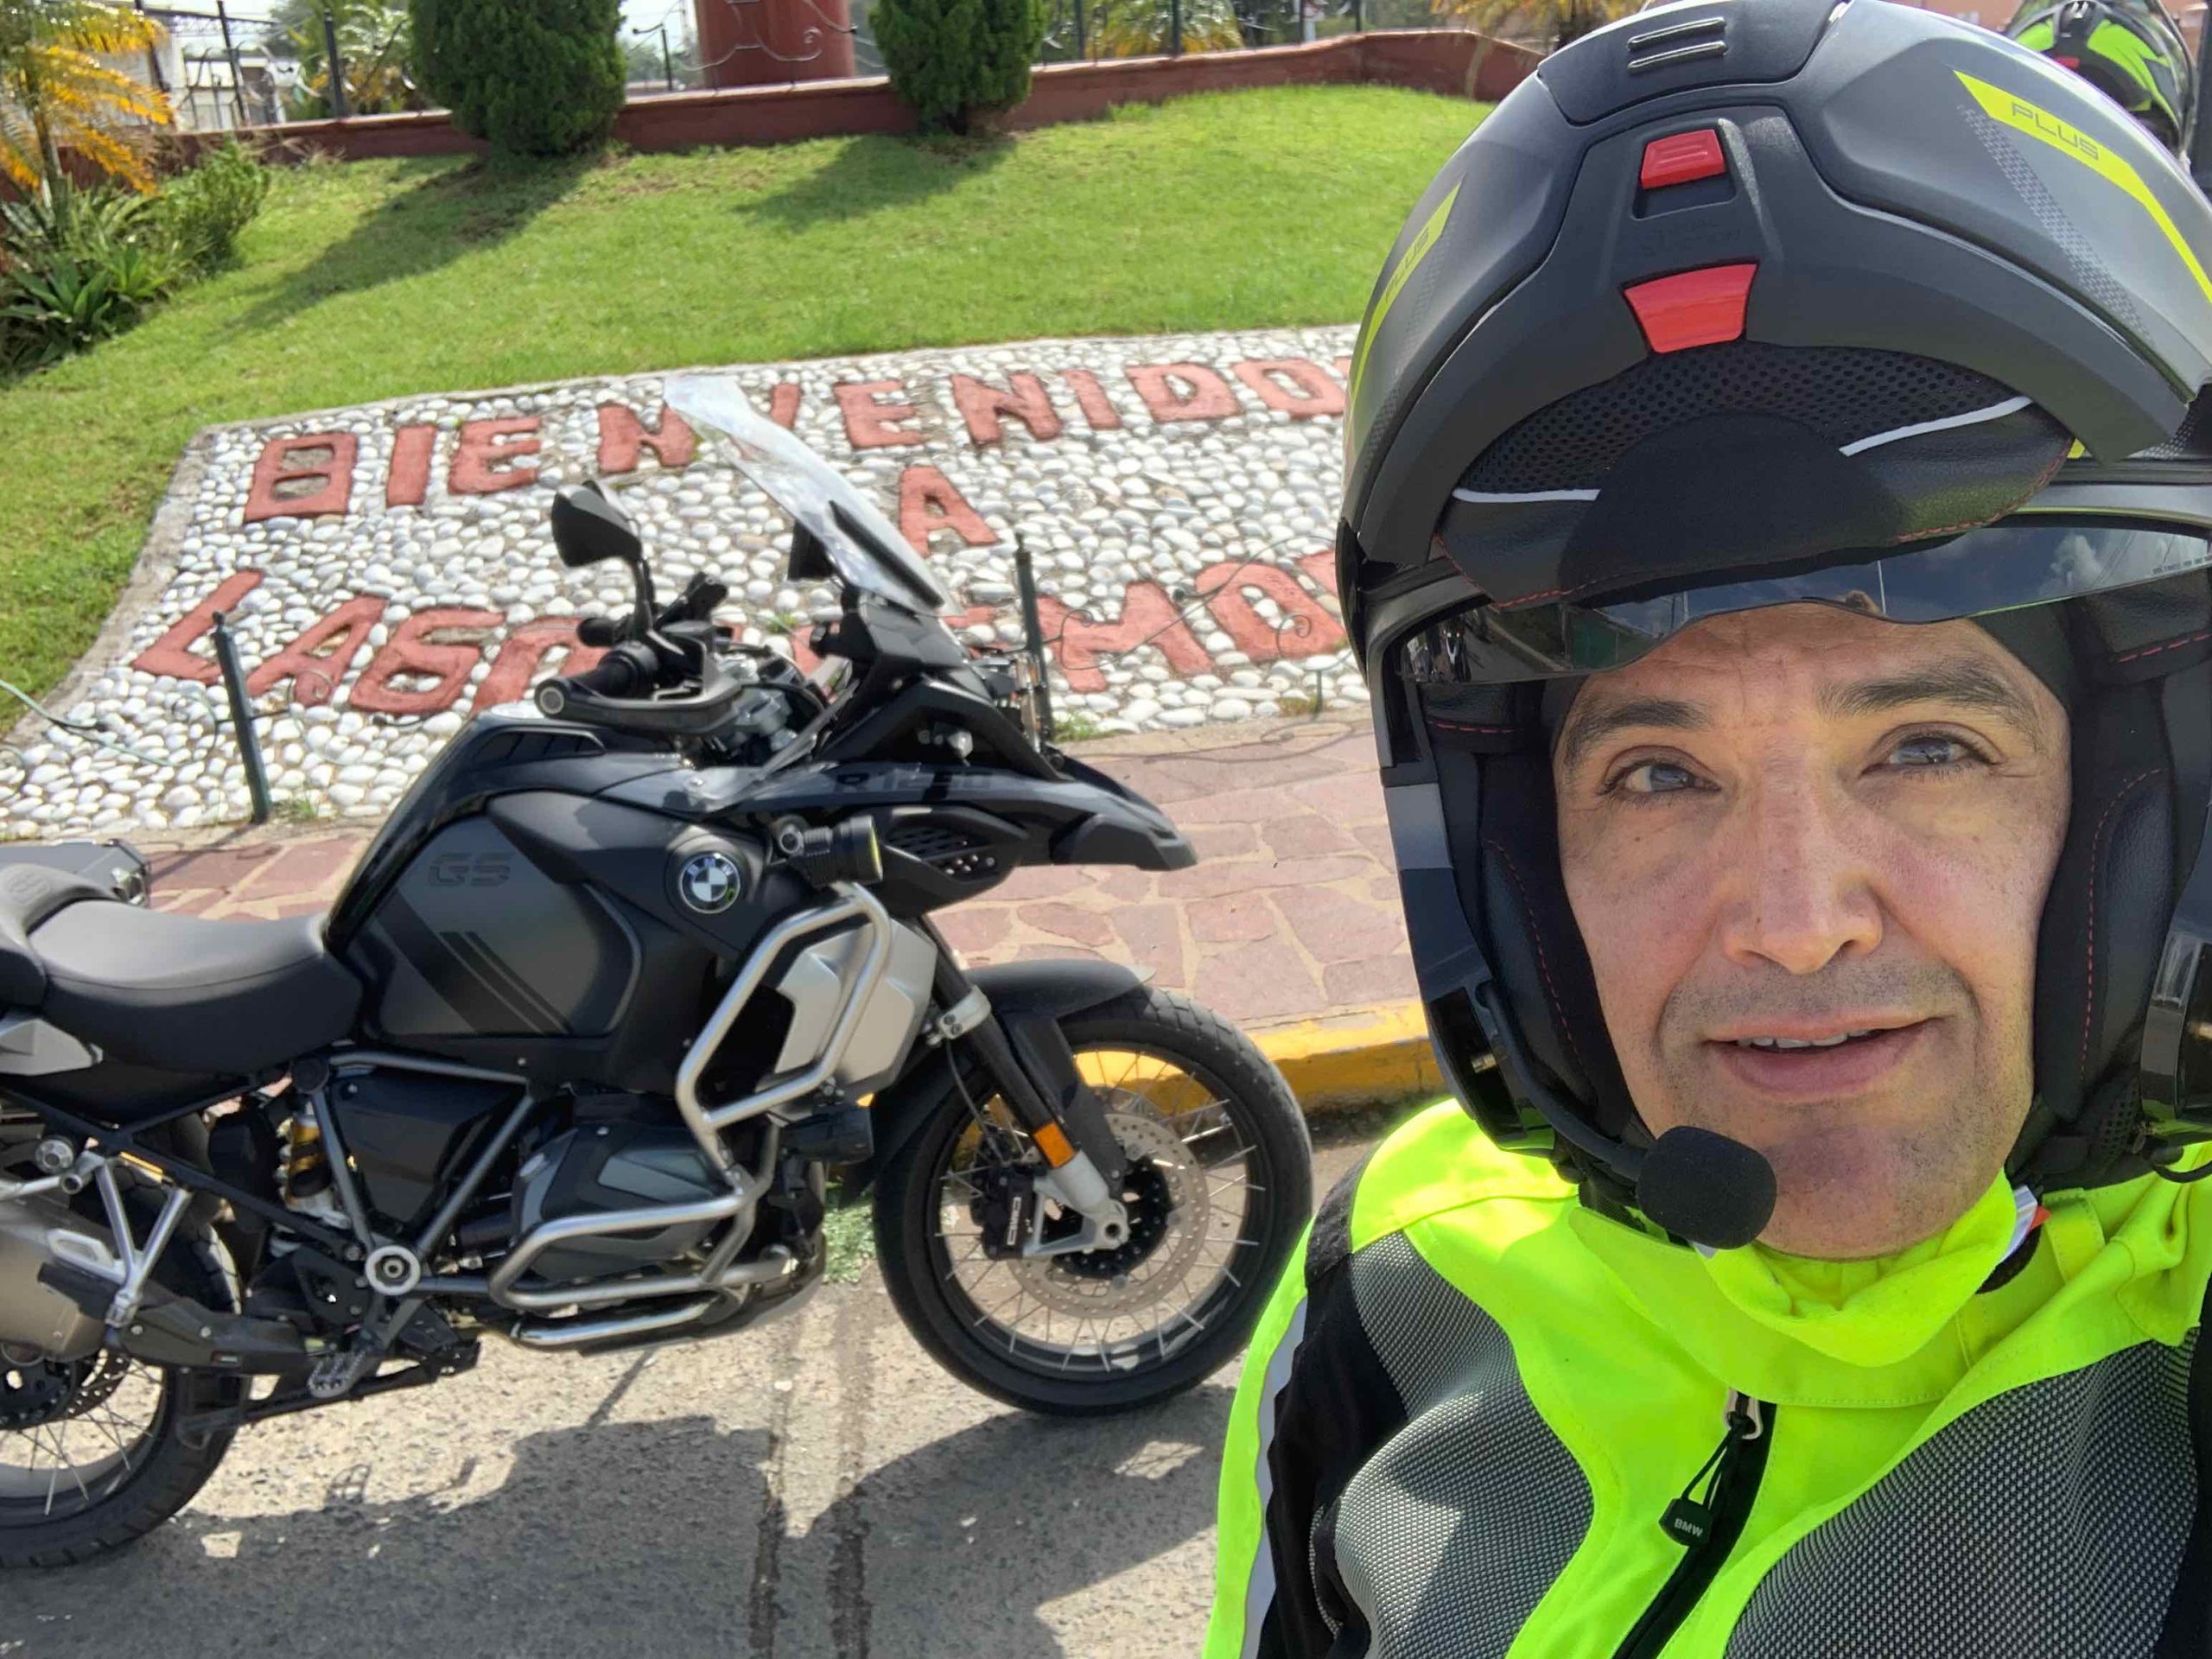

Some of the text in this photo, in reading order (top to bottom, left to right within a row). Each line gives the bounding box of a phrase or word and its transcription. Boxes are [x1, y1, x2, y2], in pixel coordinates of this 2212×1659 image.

[2011, 101, 2100, 162] PLUS
[244, 356, 1351, 520] BIENENIDO
[899, 464, 1000, 556] A
[1034, 549, 1345, 692] MO
[429, 852, 512, 887] GS
[687, 857, 734, 876] BMW
[1674, 1517, 1703, 1537] BMW
